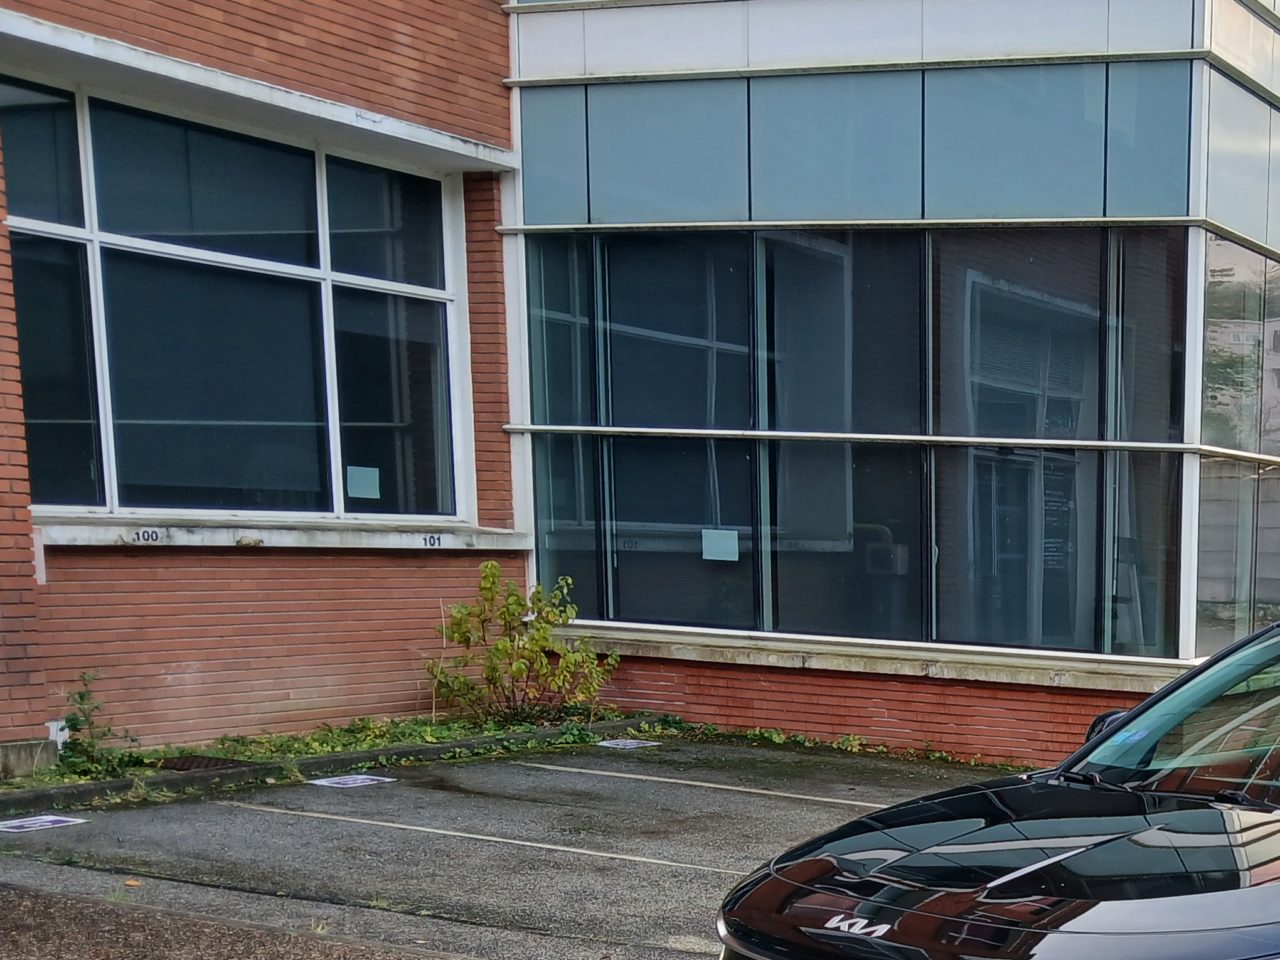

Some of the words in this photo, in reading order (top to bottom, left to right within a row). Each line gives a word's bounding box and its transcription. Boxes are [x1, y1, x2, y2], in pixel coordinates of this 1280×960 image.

[134, 530, 159, 542] 100
[422, 535, 441, 547] 101
[824, 914, 892, 938] KIA
